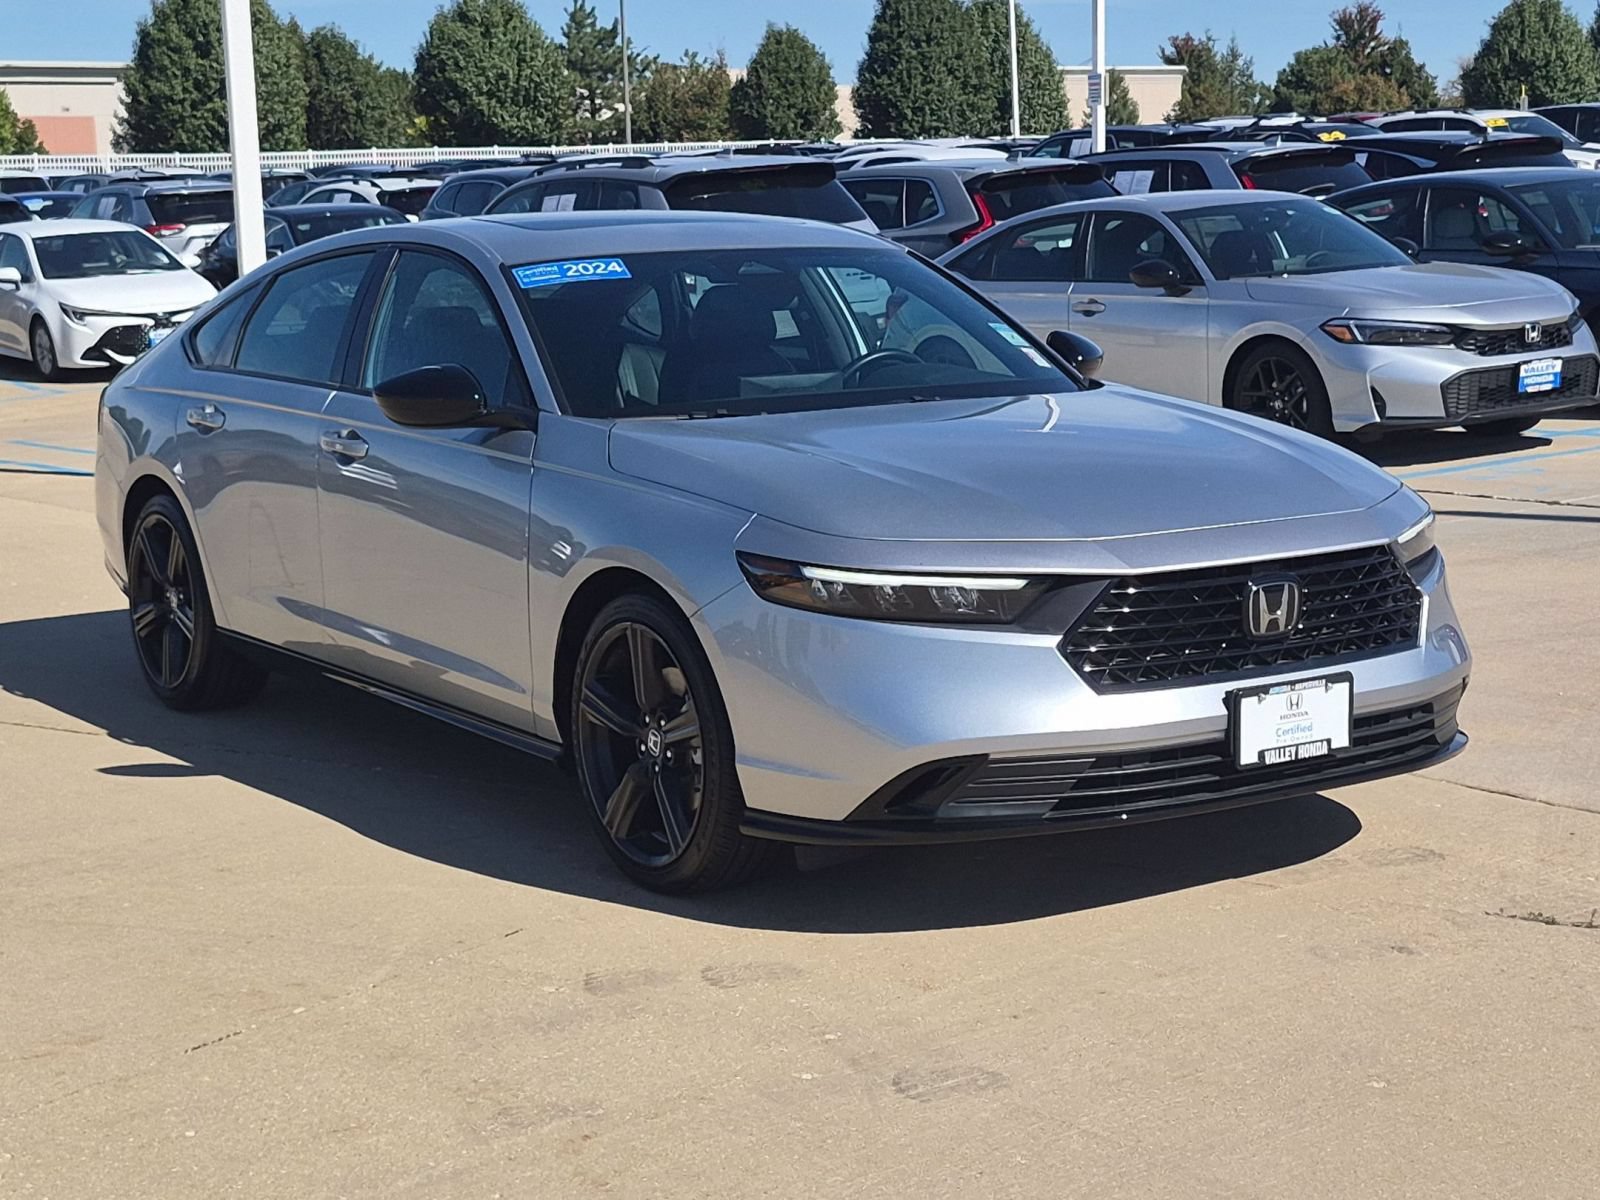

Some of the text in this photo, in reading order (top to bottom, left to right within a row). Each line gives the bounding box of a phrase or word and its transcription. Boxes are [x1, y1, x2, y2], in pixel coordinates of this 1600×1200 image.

[563, 261, 624, 276] 2024
[1524, 364, 1556, 374] VALLEY
[1523, 374, 1555, 385] HONDA
[1279, 711, 1309, 721] HONDA
[1275, 722, 1313, 738] Certified
[1264, 740, 1329, 765] VALLEY HONDA
